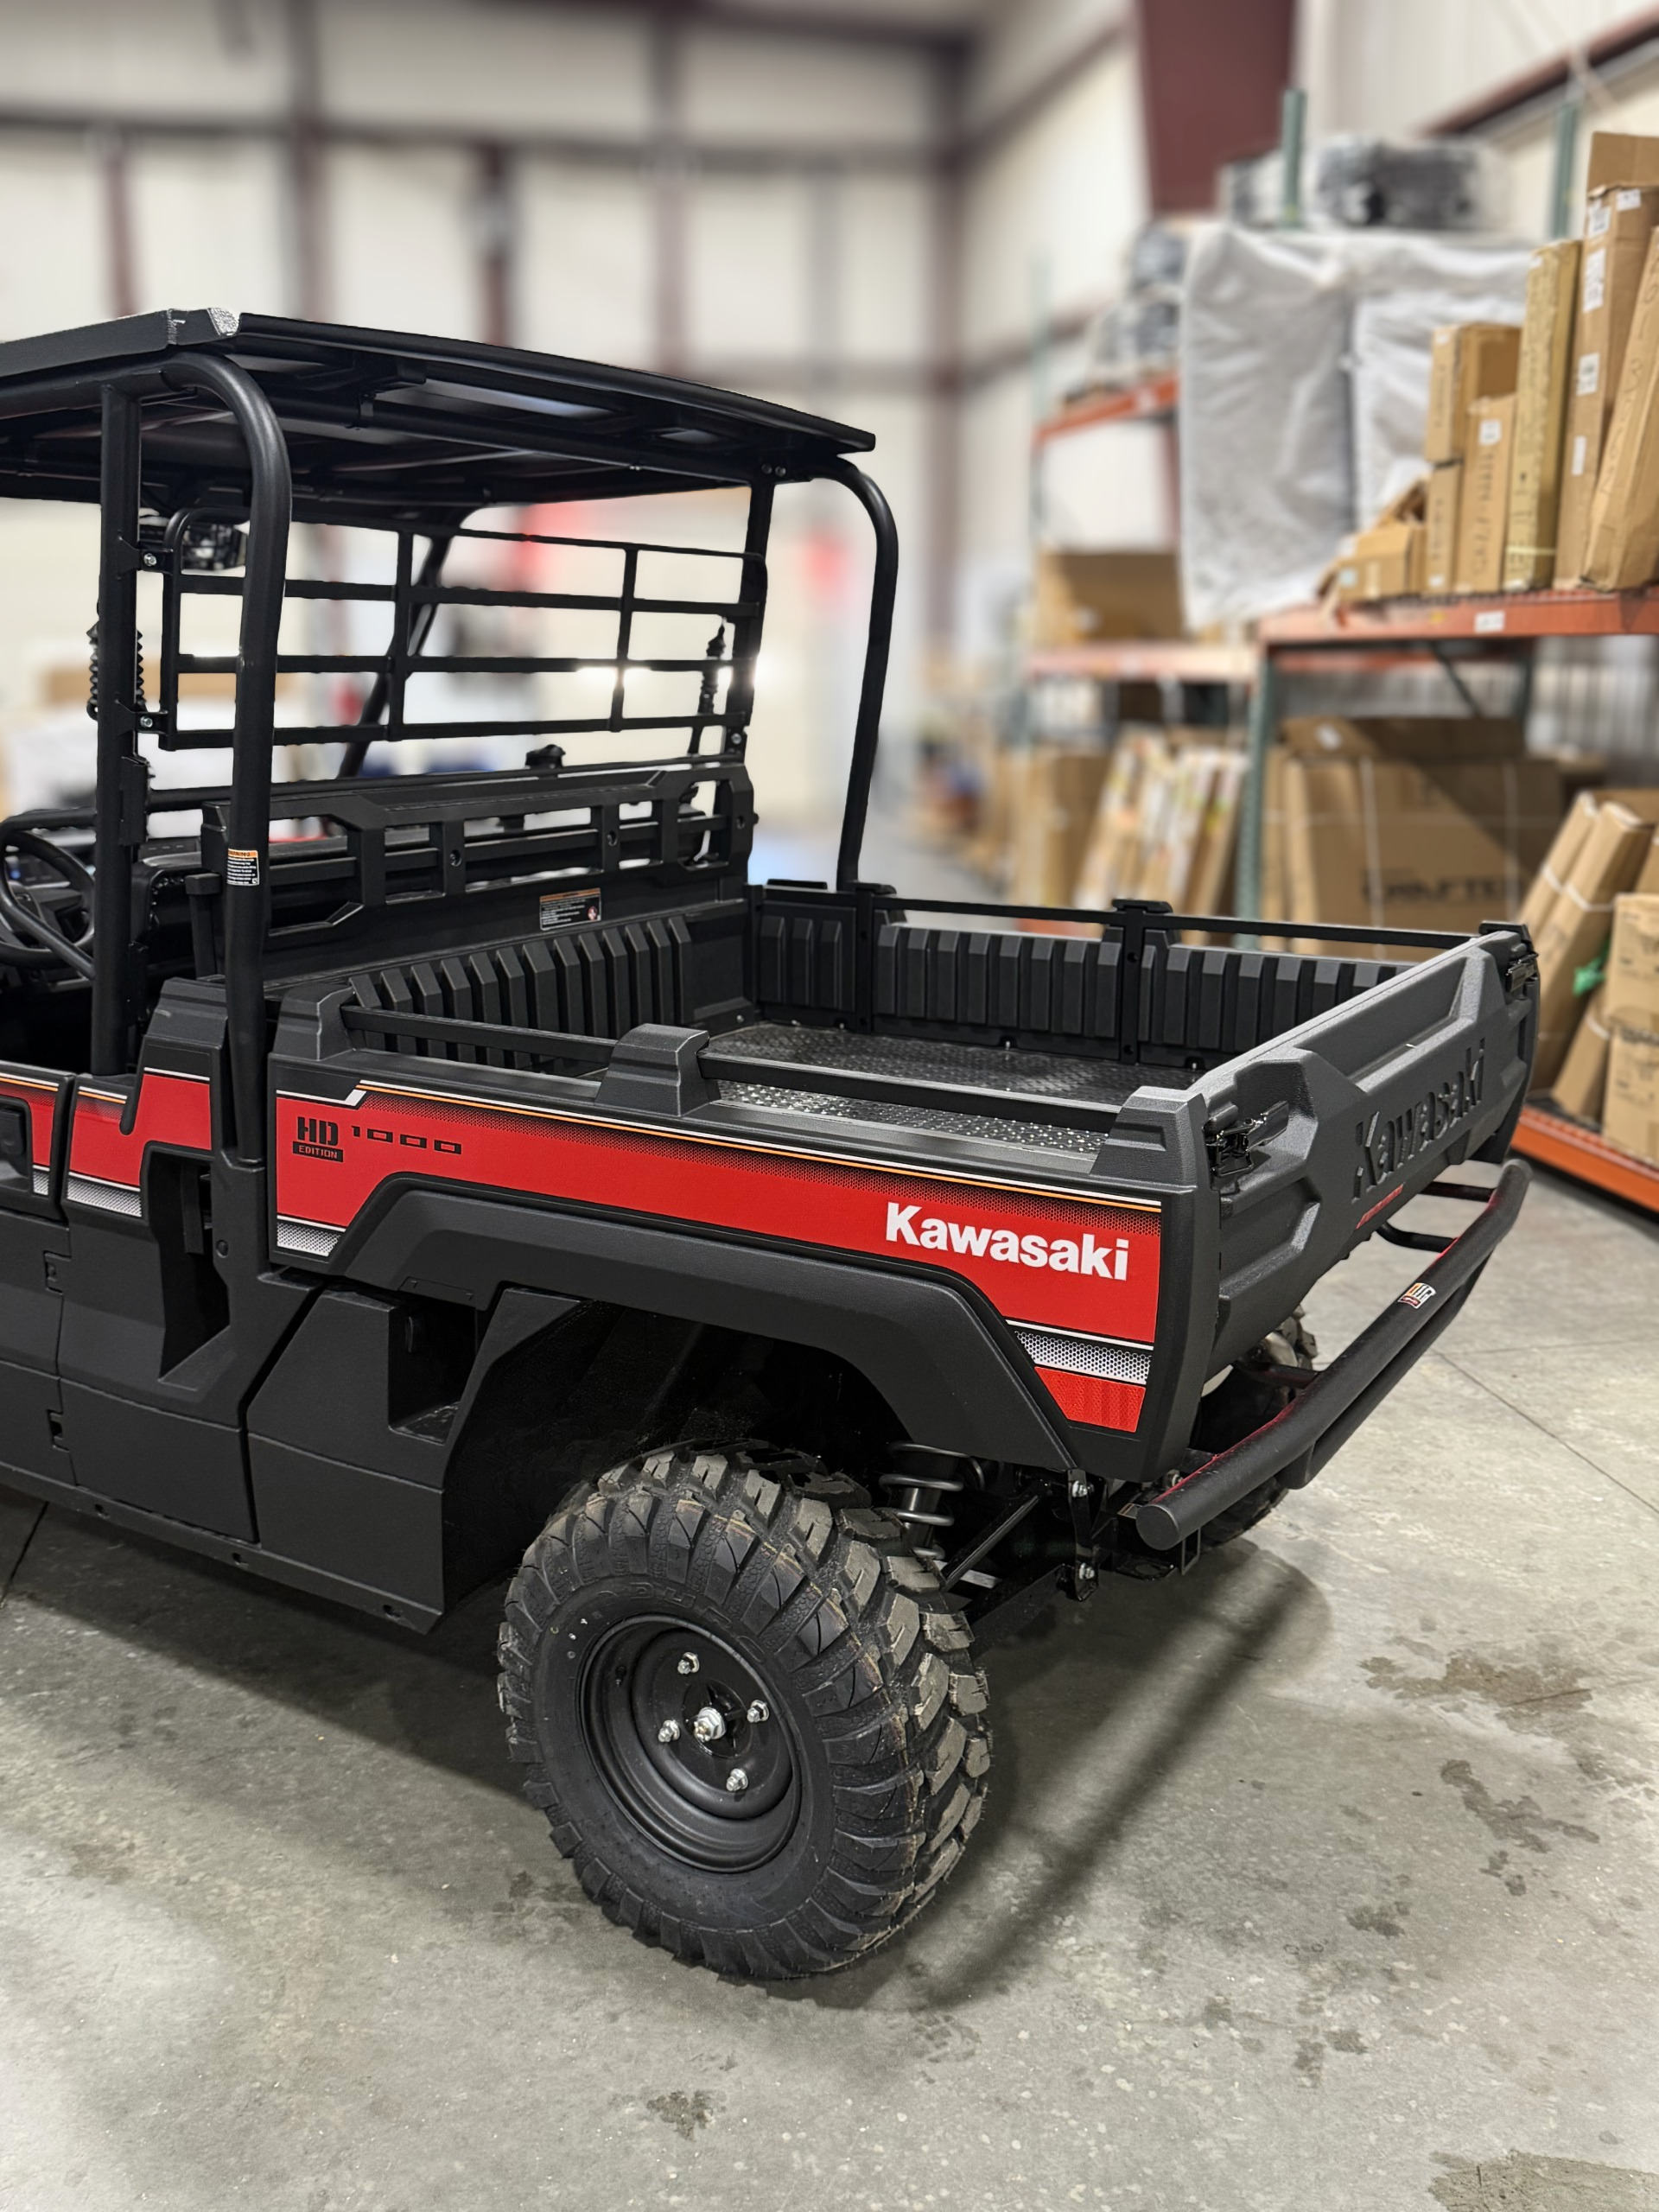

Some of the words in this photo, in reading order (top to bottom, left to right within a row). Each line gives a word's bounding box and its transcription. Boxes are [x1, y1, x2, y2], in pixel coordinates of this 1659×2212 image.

[297, 1116, 339, 1147] HD
[351, 1125, 462, 1155] 1000
[1351, 1038, 1485, 1202] Kawasaki
[298, 1145, 338, 1160] EDITION
[886, 1201, 1129, 1281] Kawasaki
